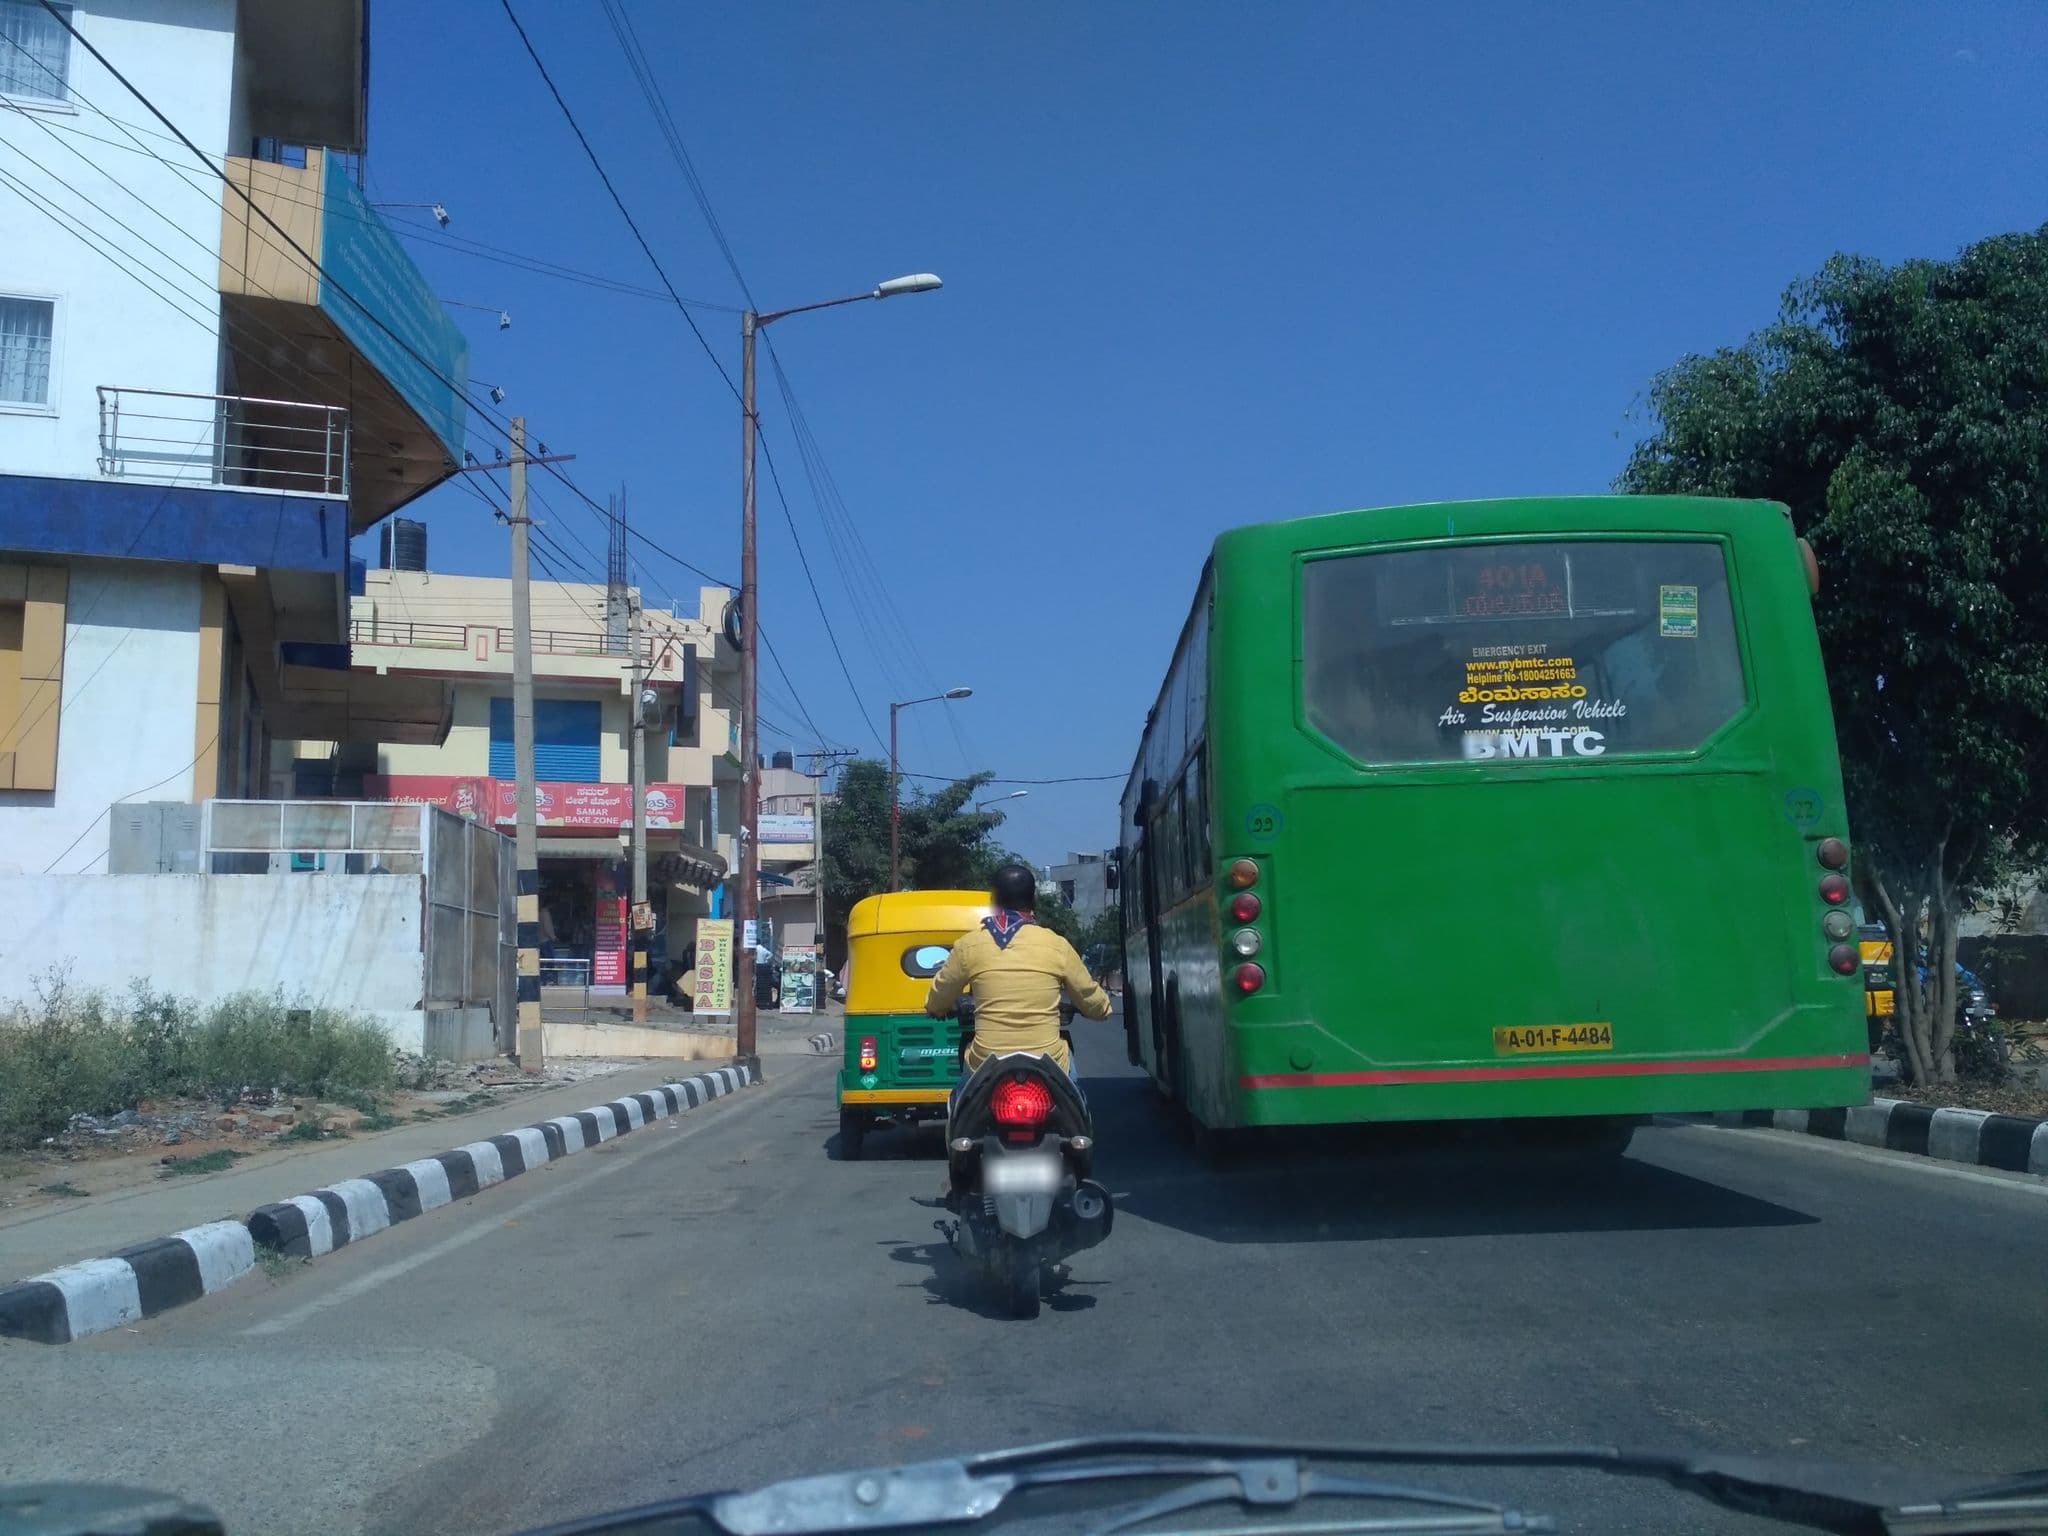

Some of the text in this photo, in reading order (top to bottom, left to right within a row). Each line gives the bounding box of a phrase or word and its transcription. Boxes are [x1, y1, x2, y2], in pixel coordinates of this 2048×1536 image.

[1472, 644, 1547, 658] EMERGENCY EXIT
[1466, 657, 1573, 672] www.mybmtc.com
[1467, 671, 1503, 686] Helpline
[1438, 698, 1626, 727] Air Suspension Vehicle
[576, 808, 608, 816] SAMAR
[565, 816, 619, 825] BAKE ZONE
[695, 938, 716, 1008] BASHA
